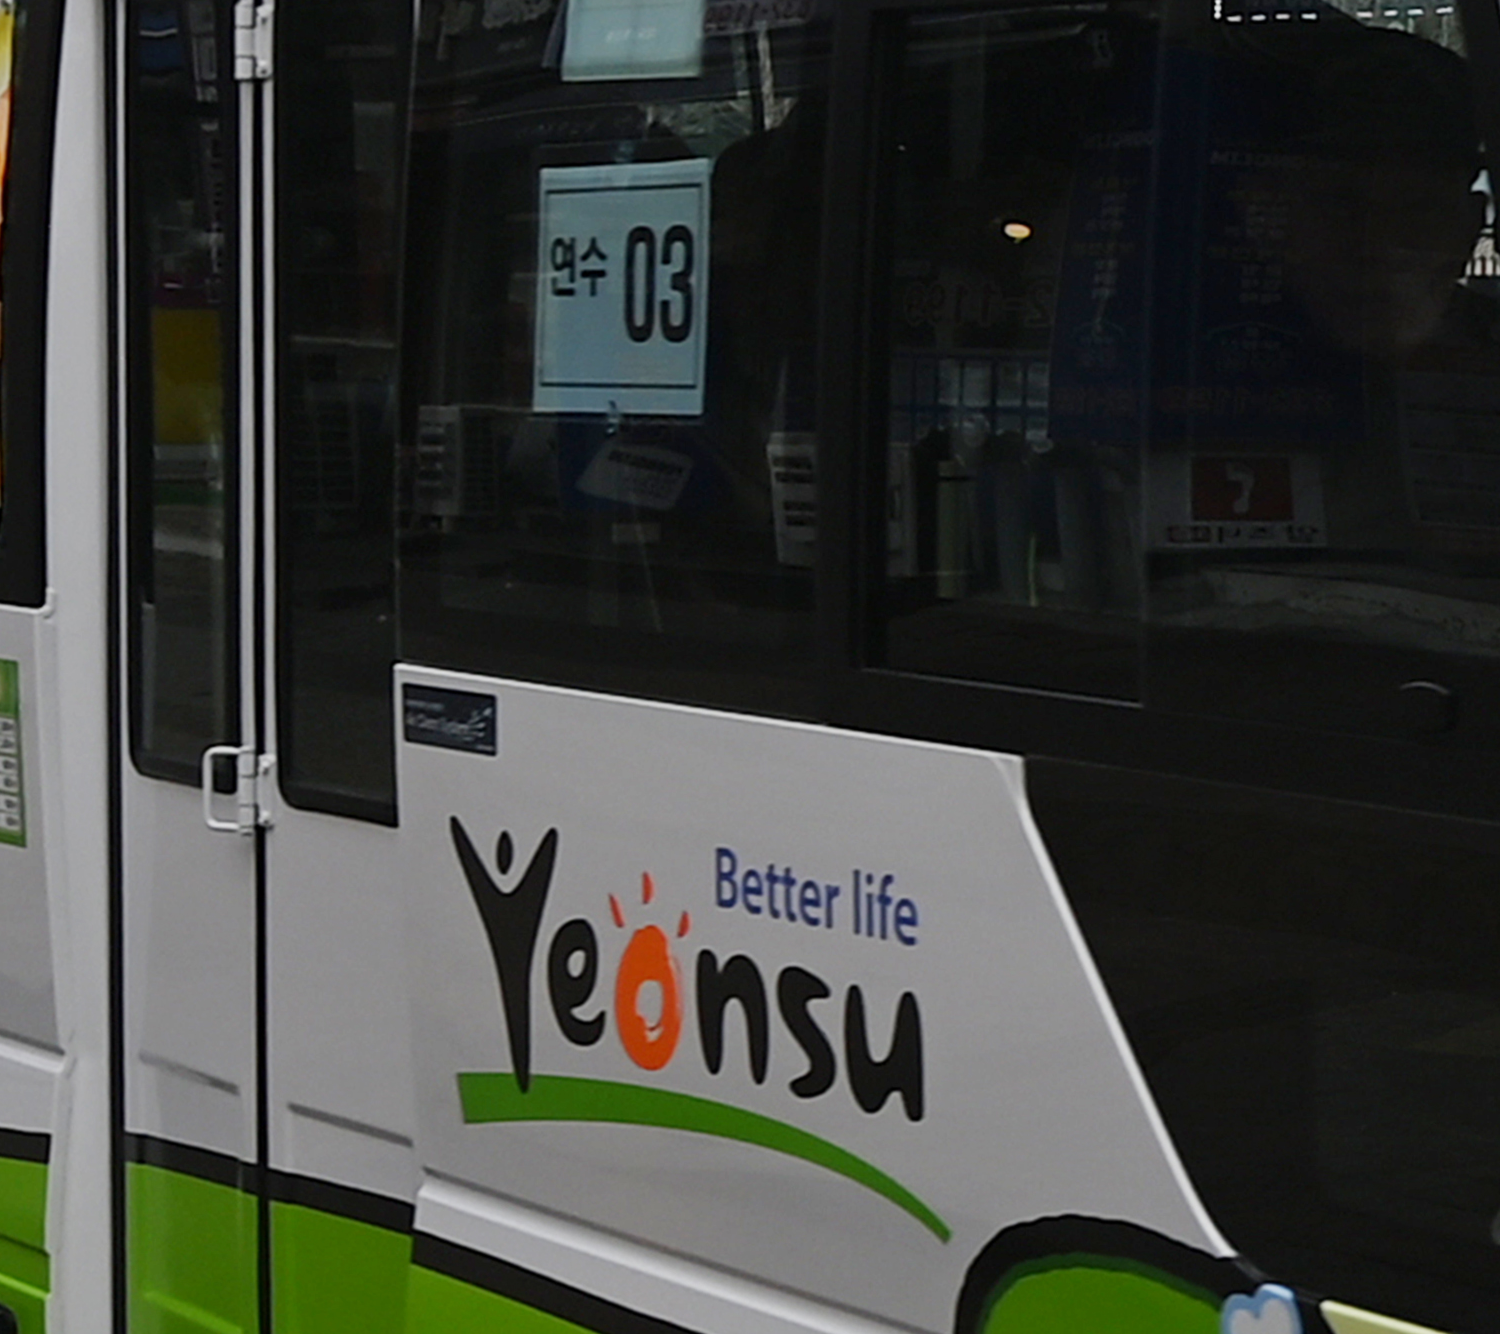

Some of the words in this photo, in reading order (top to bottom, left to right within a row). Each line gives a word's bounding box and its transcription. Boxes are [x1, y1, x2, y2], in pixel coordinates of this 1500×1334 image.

[550, 237, 607, 297] 연수
[624, 224, 694, 343] 03
[715, 847, 839, 929] Better
[853, 870, 919, 947] life
[450, 815, 925, 1122] Yeonsu
